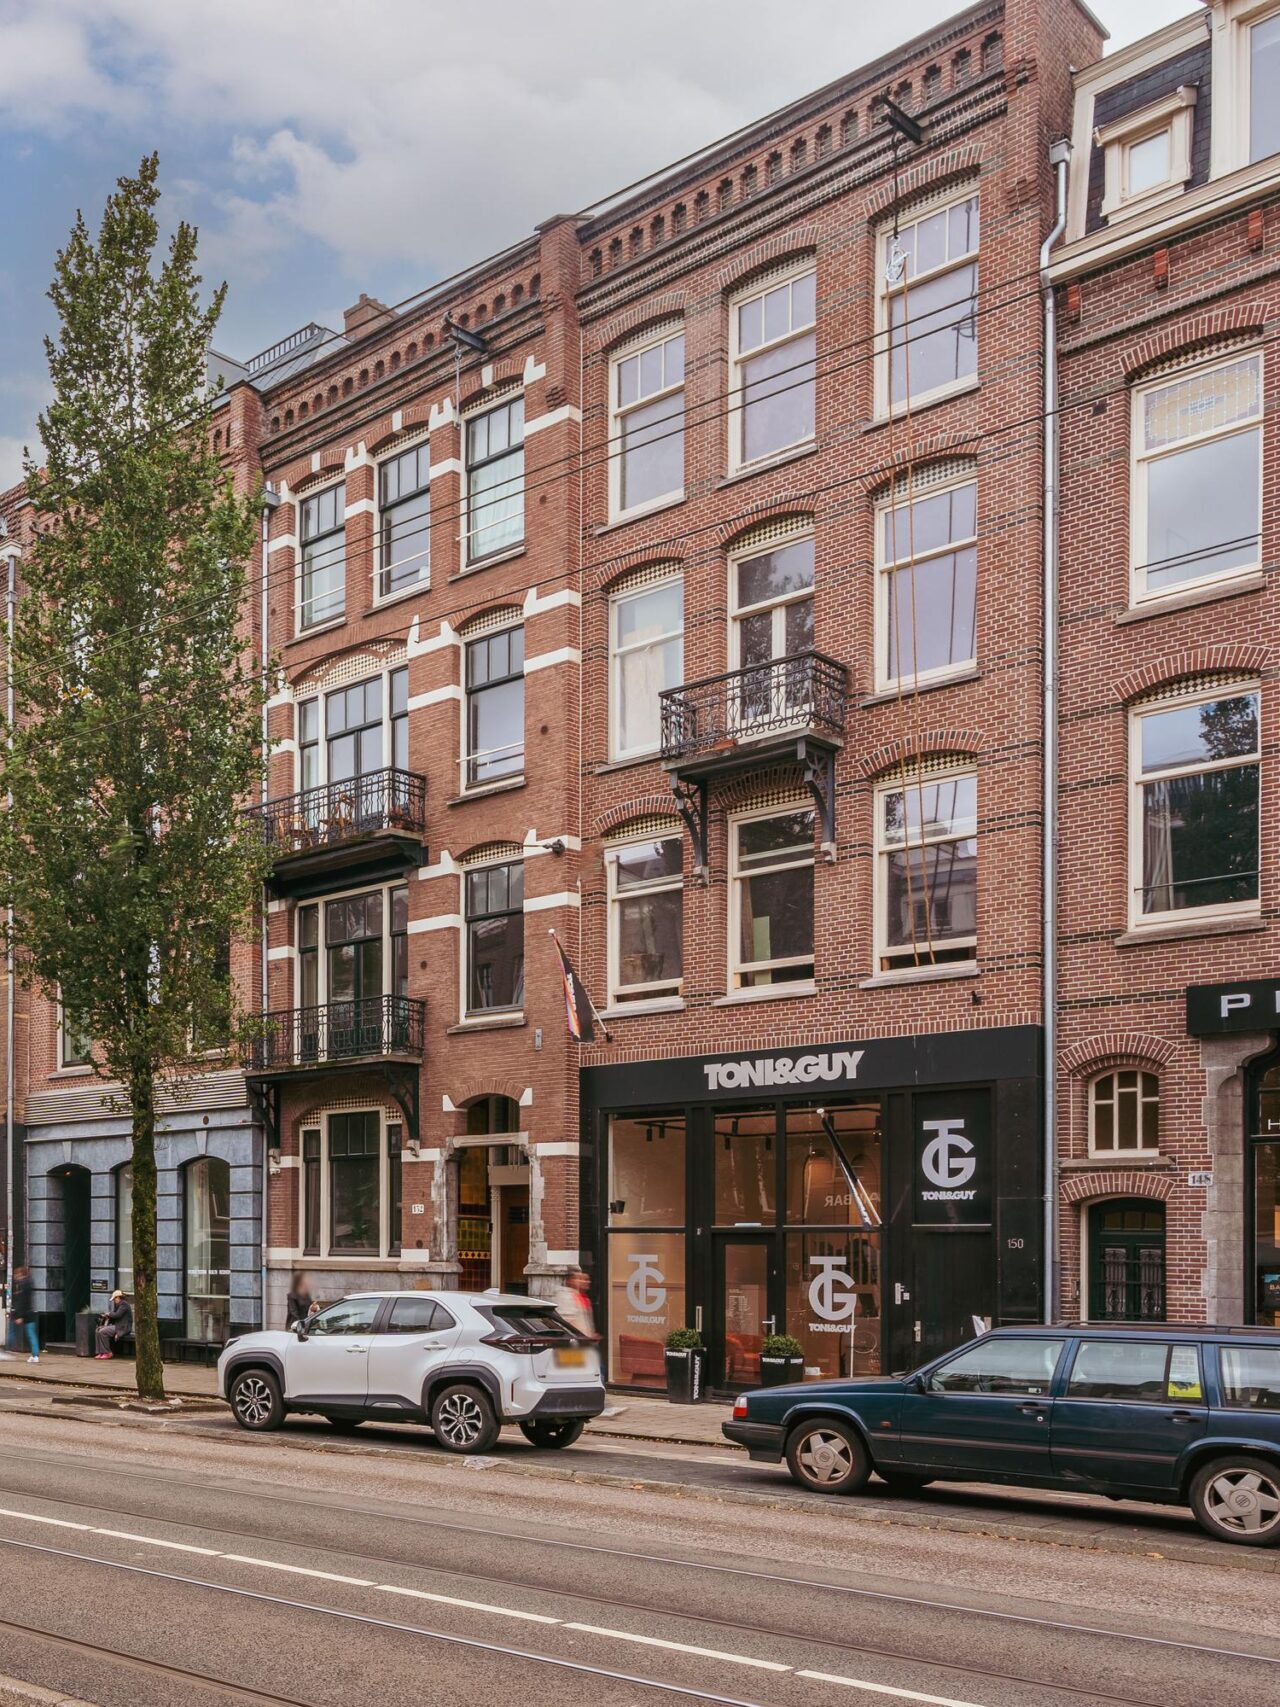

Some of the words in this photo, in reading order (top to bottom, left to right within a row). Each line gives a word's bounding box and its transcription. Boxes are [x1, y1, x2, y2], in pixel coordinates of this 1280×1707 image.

[1220, 990, 1280, 1017] P
[704, 1051, 865, 1090] TONI&GUY
[1191, 1174, 1211, 1185] 148
[922, 1190, 977, 1201] TONI&GUY
[1007, 1238, 1024, 1249] 150
[626, 1315, 666, 1324] TONI&GUY
[809, 1323, 857, 1333] TONI&GUY
